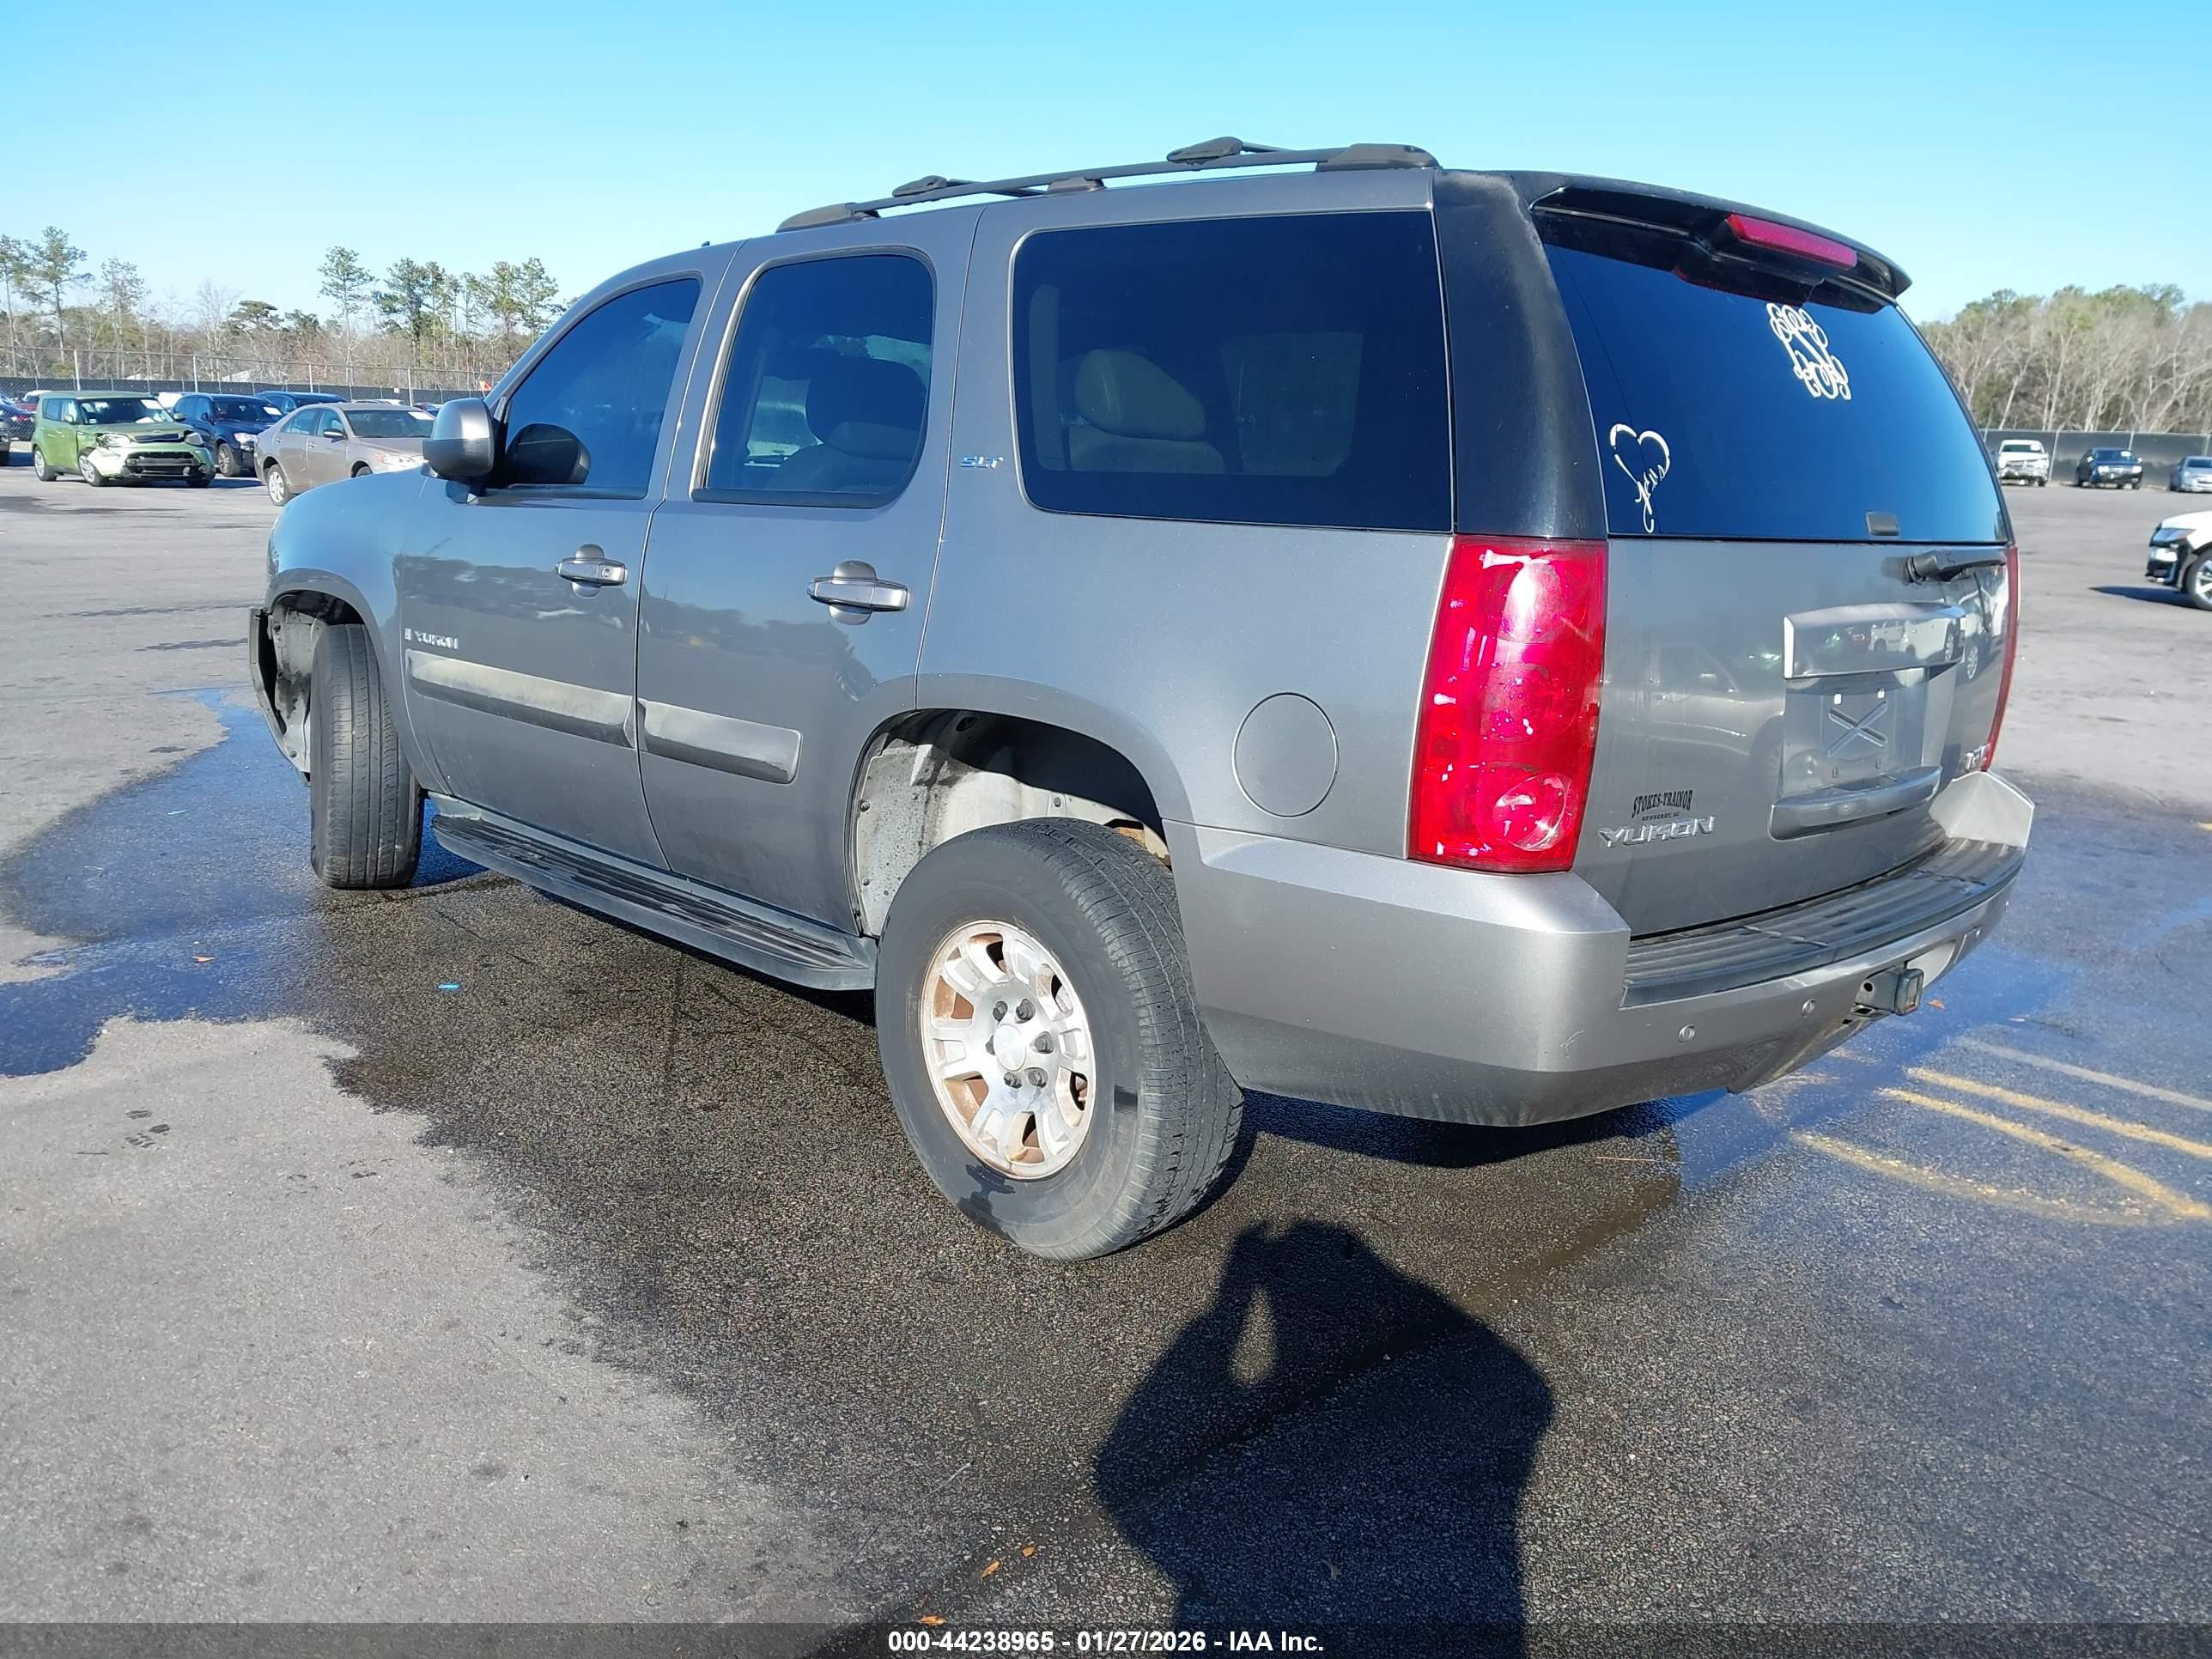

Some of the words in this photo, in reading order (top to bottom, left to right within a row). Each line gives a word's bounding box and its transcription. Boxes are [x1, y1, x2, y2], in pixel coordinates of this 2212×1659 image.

[961, 456, 1004, 469] SLT
[413, 630, 459, 650] YUKON
[1631, 789, 1693, 818] STOKES-TRAINOR
[1598, 816, 1717, 848] YUKON
